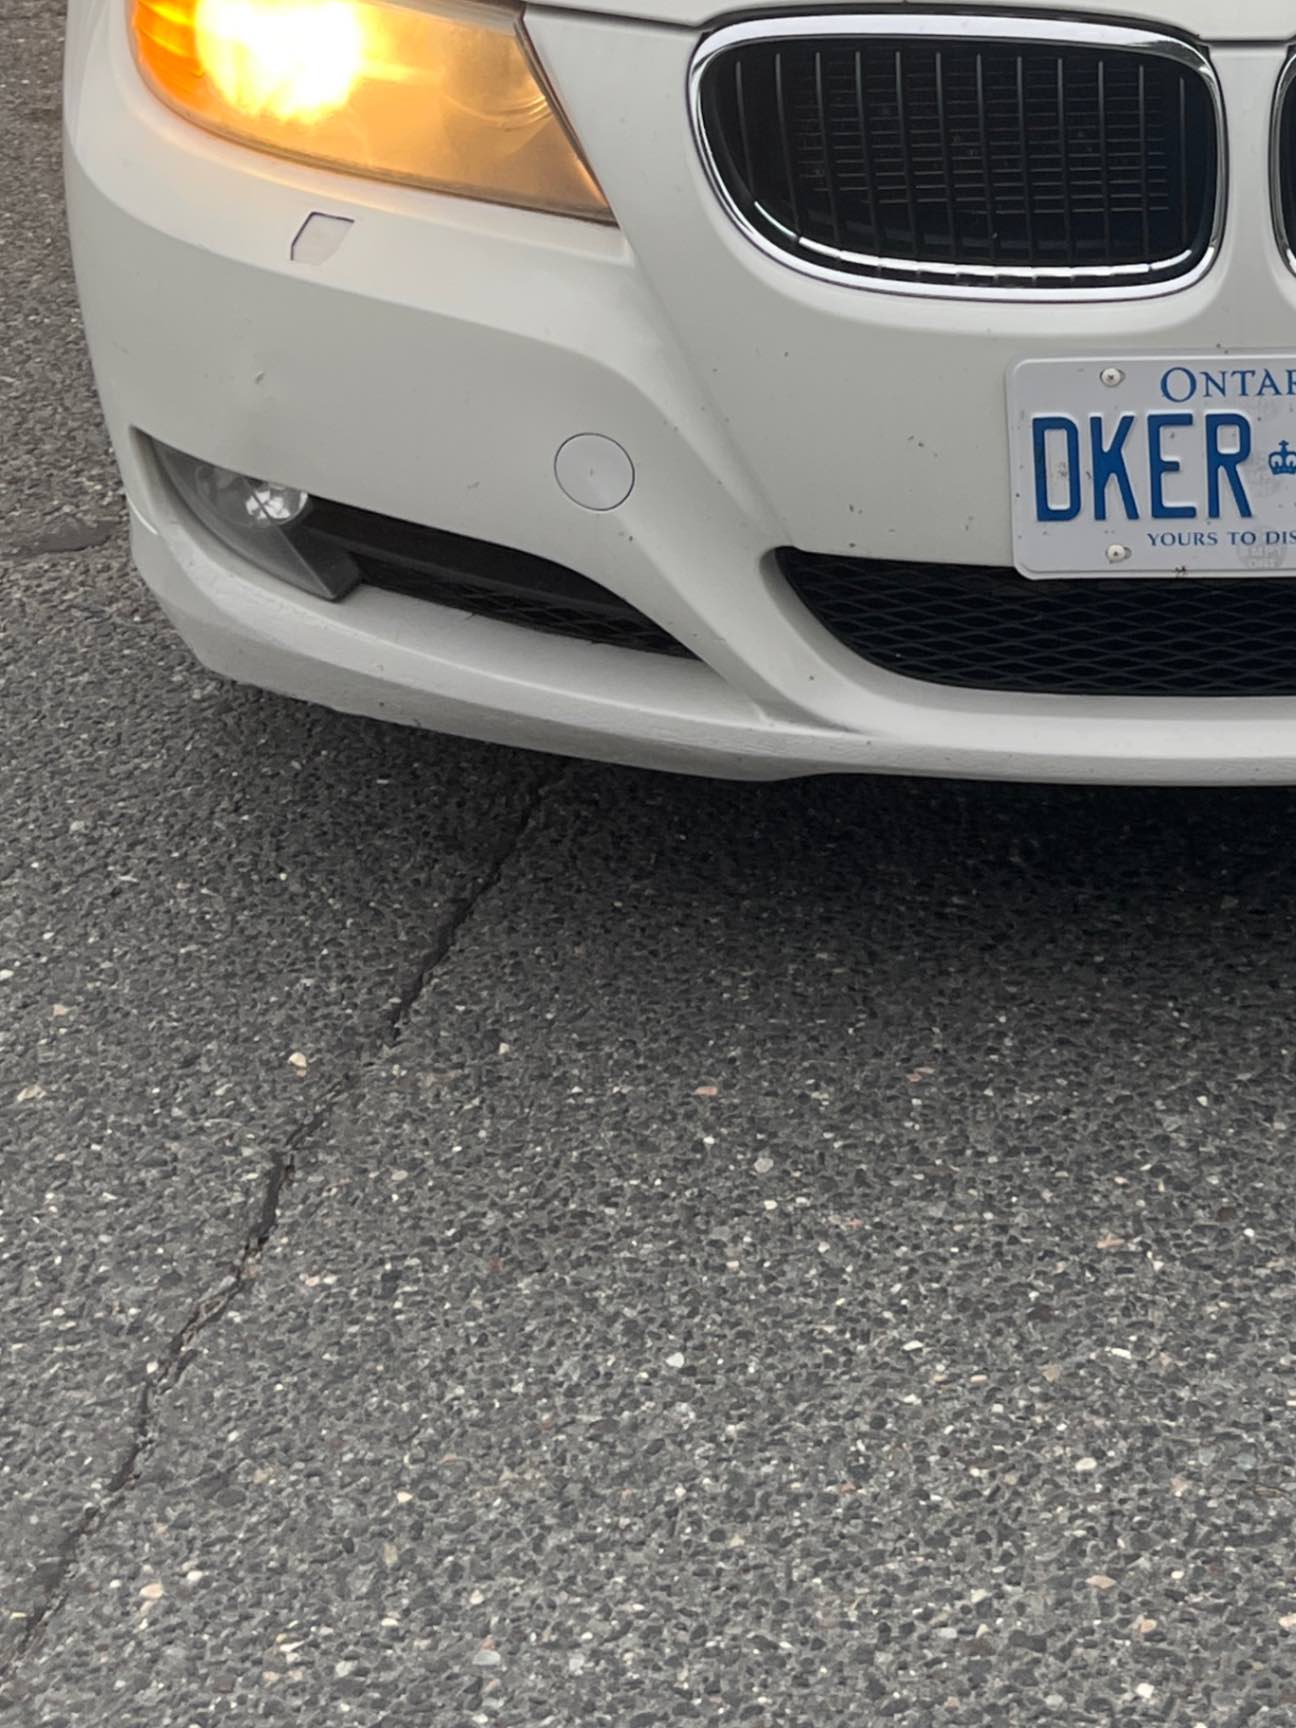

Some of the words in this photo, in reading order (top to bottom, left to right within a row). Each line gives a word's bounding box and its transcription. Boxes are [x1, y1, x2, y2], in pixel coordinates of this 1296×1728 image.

[1032, 412, 1252, 523] DKER
[1147, 530, 1217, 547] YOURS
[1227, 530, 1257, 546] TO
